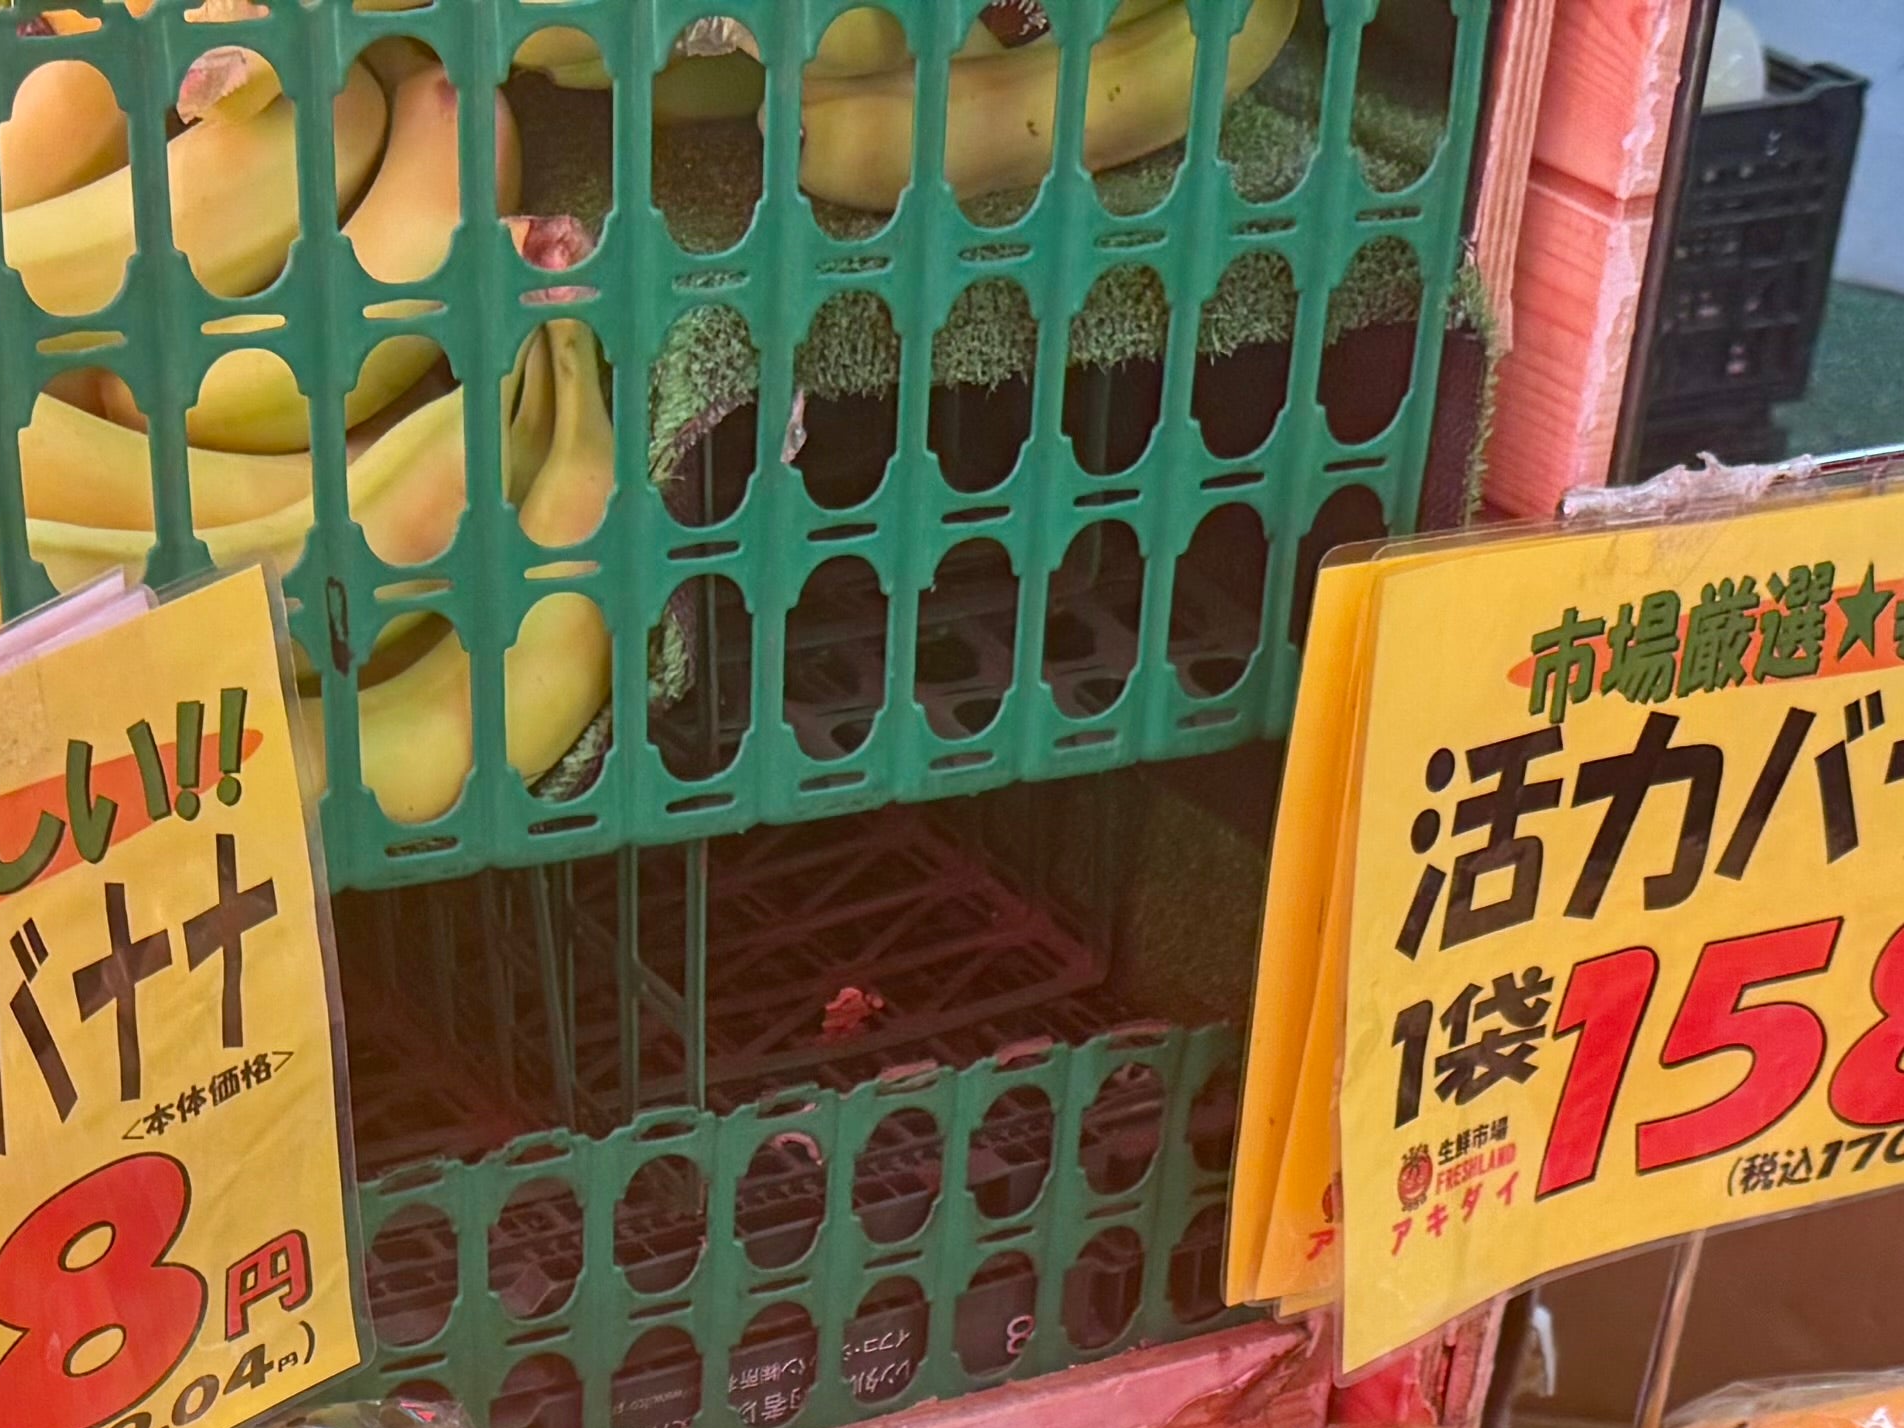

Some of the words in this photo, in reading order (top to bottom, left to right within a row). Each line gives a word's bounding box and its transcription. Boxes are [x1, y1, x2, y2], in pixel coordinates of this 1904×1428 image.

[1390, 964, 1558, 1130] 1袋
[1435, 1142, 1518, 1192] FRESHLAND
[1438, 1116, 1510, 1166] 生鮮市場
[1390, 1177, 1518, 1256] アキダイ
